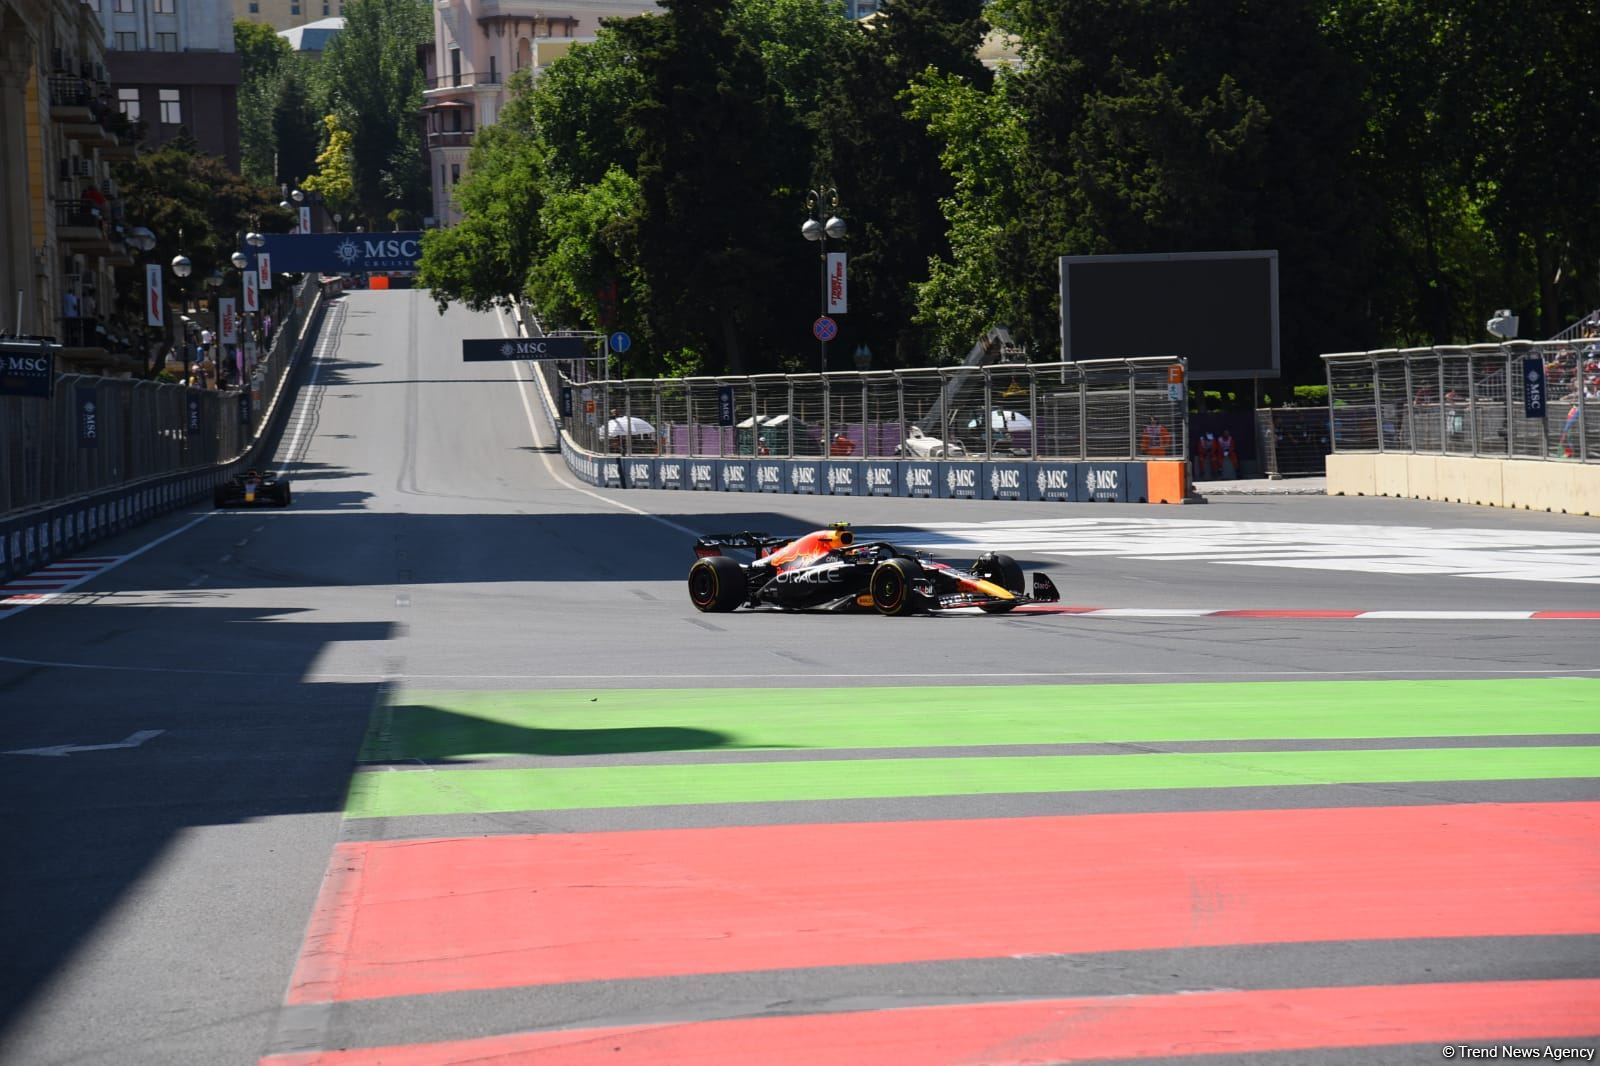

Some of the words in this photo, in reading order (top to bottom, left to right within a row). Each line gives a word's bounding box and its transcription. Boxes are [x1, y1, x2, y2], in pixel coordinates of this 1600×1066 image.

[364, 239, 417, 258] MSC
[516, 342, 548, 354] MSC
[9, 356, 48, 371] MSC
[1170, 367, 1179, 382] F
[1531, 383, 1540, 408] MSC
[86, 414, 97, 439] MSC
[665, 464, 680, 480] MSC
[696, 465, 711, 481] MSC
[730, 466, 745, 481] MSC
[764, 466, 780, 482] MSC
[799, 467, 815, 483] MSC
[835, 467, 852, 484] MSC
[874, 468, 892, 485] MSC
[914, 468, 932, 486] MSC
[956, 469, 975, 487] MSC
[1000, 470, 1019, 488] MSC
[1047, 470, 1068, 489] MSC
[1096, 470, 1118, 489] MSC
[776, 567, 841, 583] ORACLE
